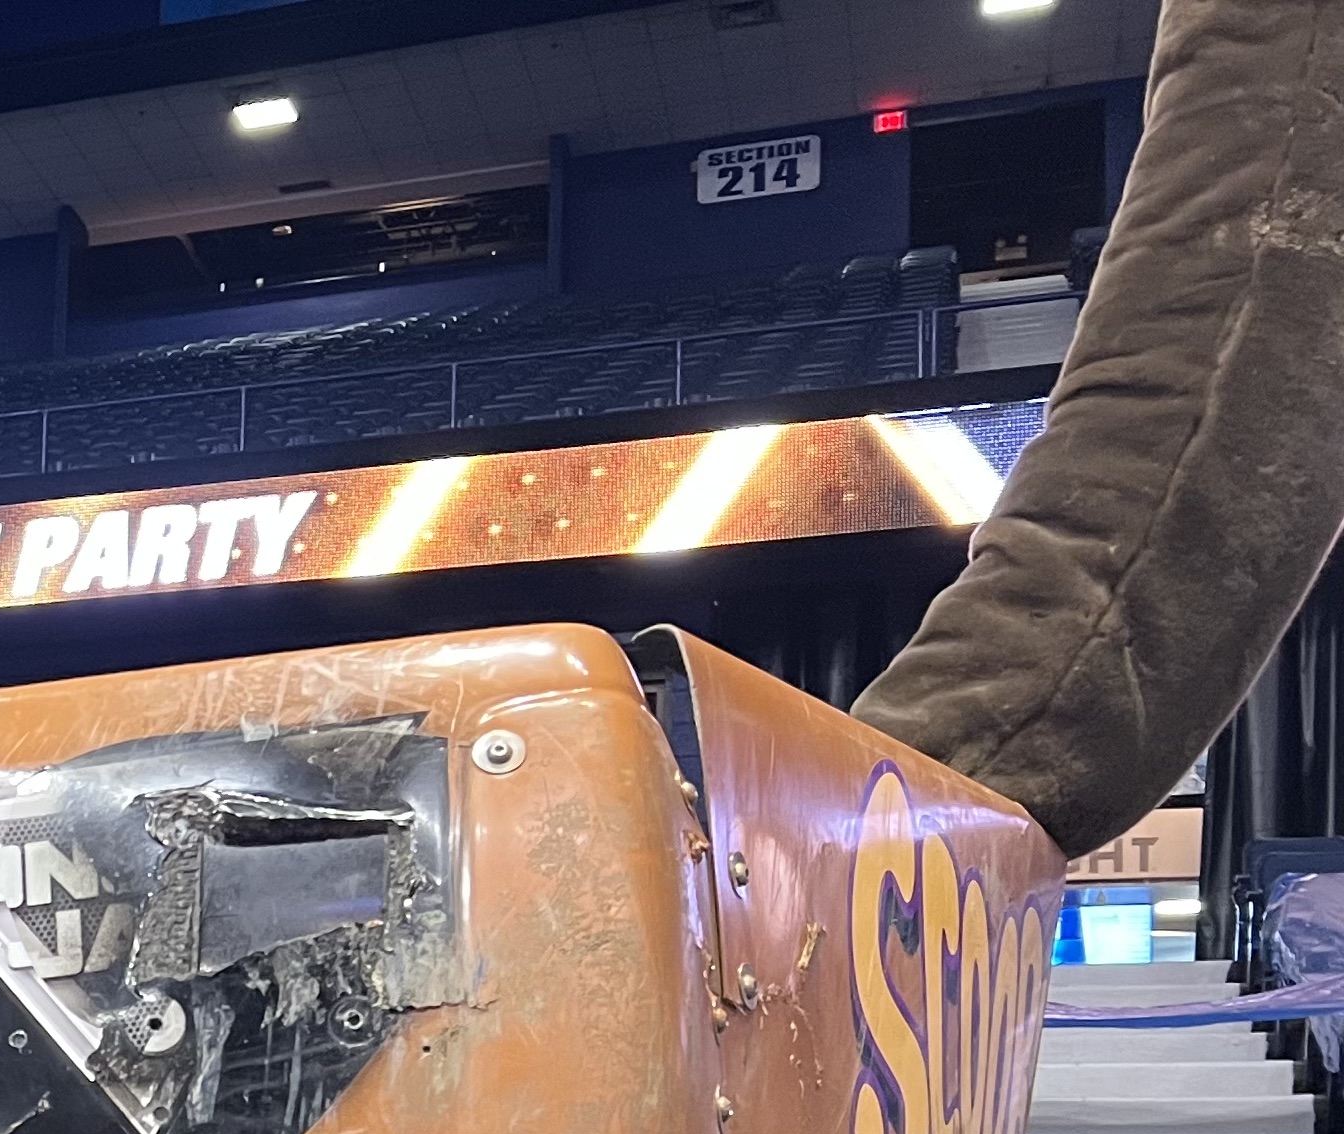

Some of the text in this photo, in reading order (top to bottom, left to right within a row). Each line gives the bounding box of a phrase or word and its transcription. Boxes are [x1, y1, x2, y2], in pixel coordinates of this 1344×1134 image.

[707, 139, 811, 167] SECTION
[716, 157, 801, 198] 214
[10, 490, 320, 600] PARTY
